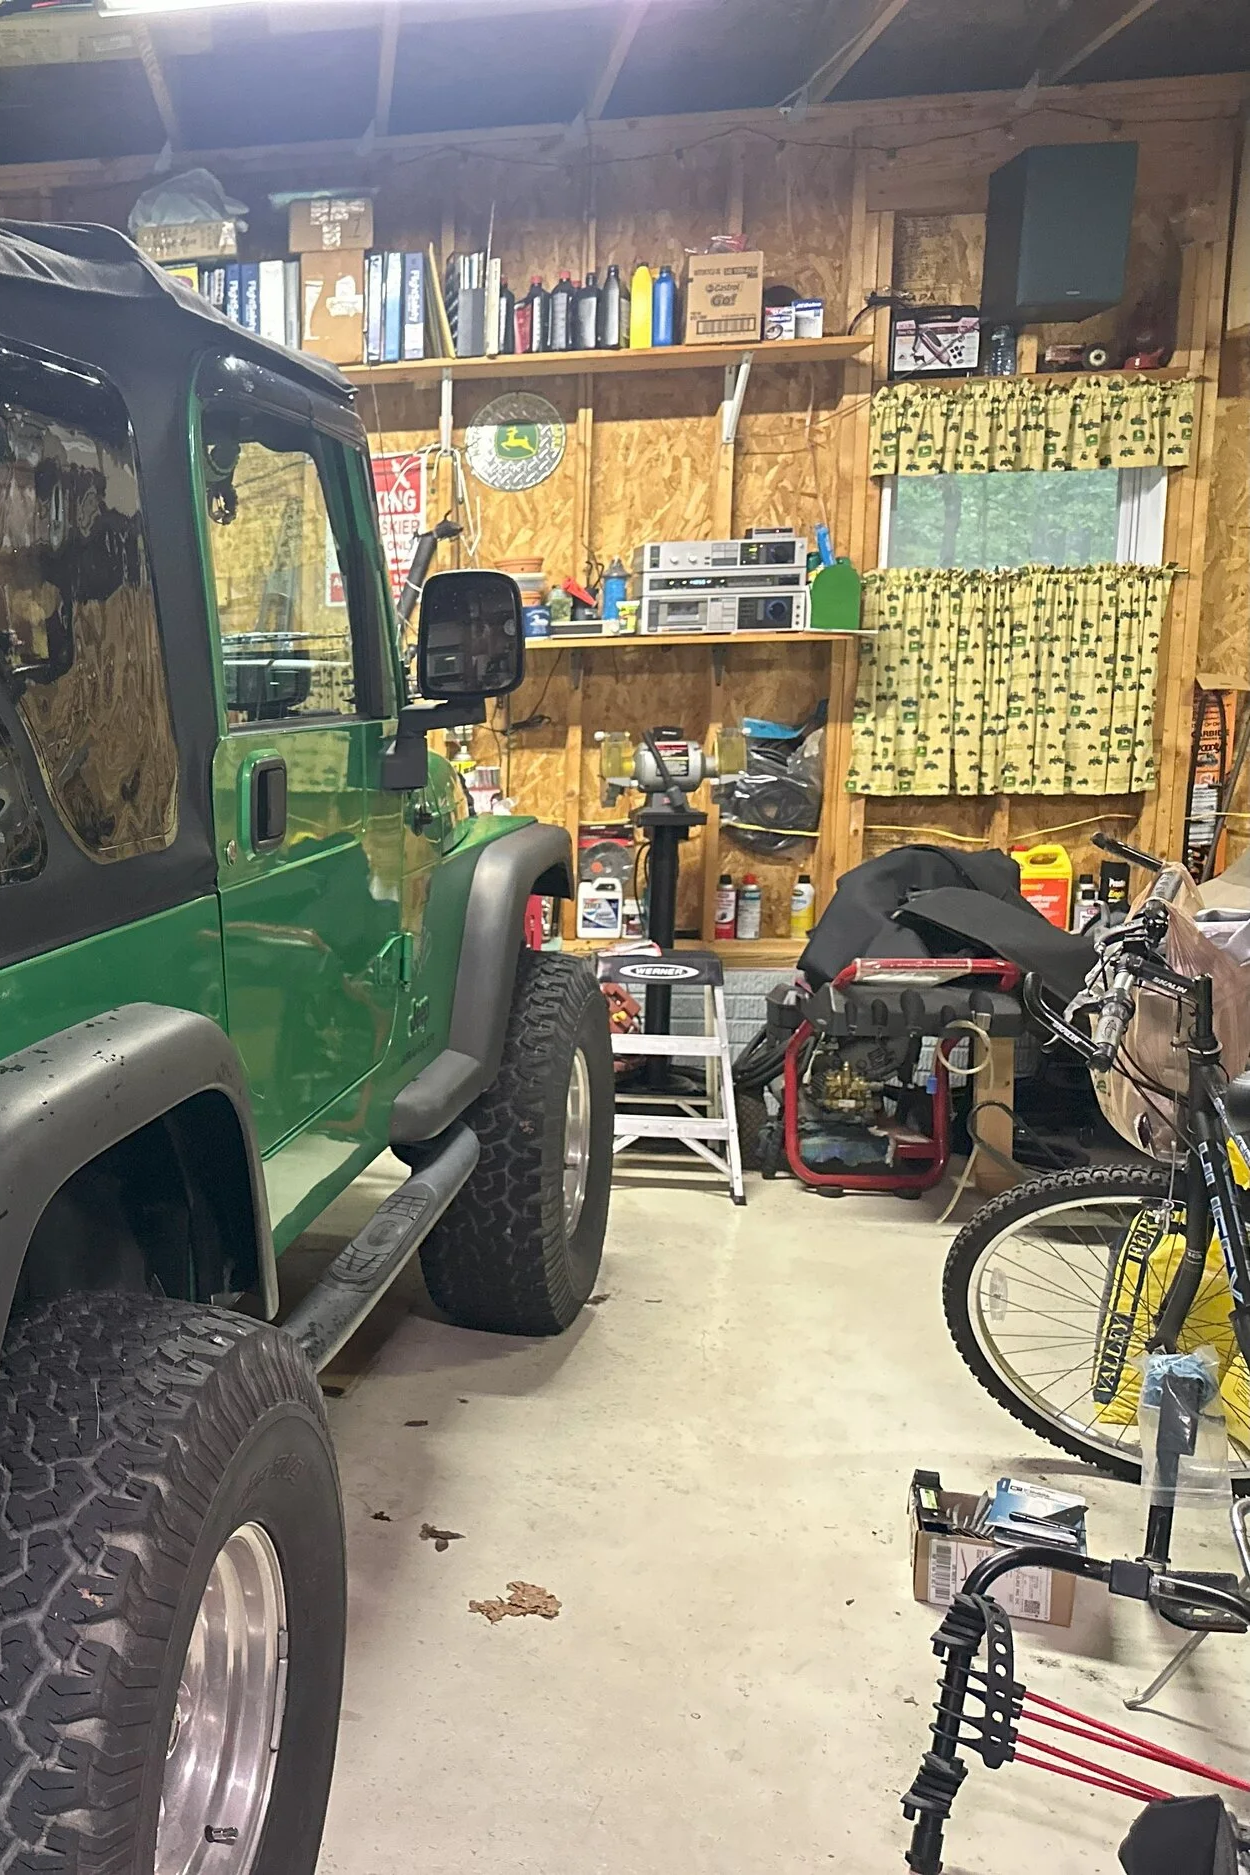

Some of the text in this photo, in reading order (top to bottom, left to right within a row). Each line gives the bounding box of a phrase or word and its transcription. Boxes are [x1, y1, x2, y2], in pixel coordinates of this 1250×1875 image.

[710, 294, 737, 307] Go!
[376, 490, 417, 512] KING
[635, 967, 684, 975] WERNER
